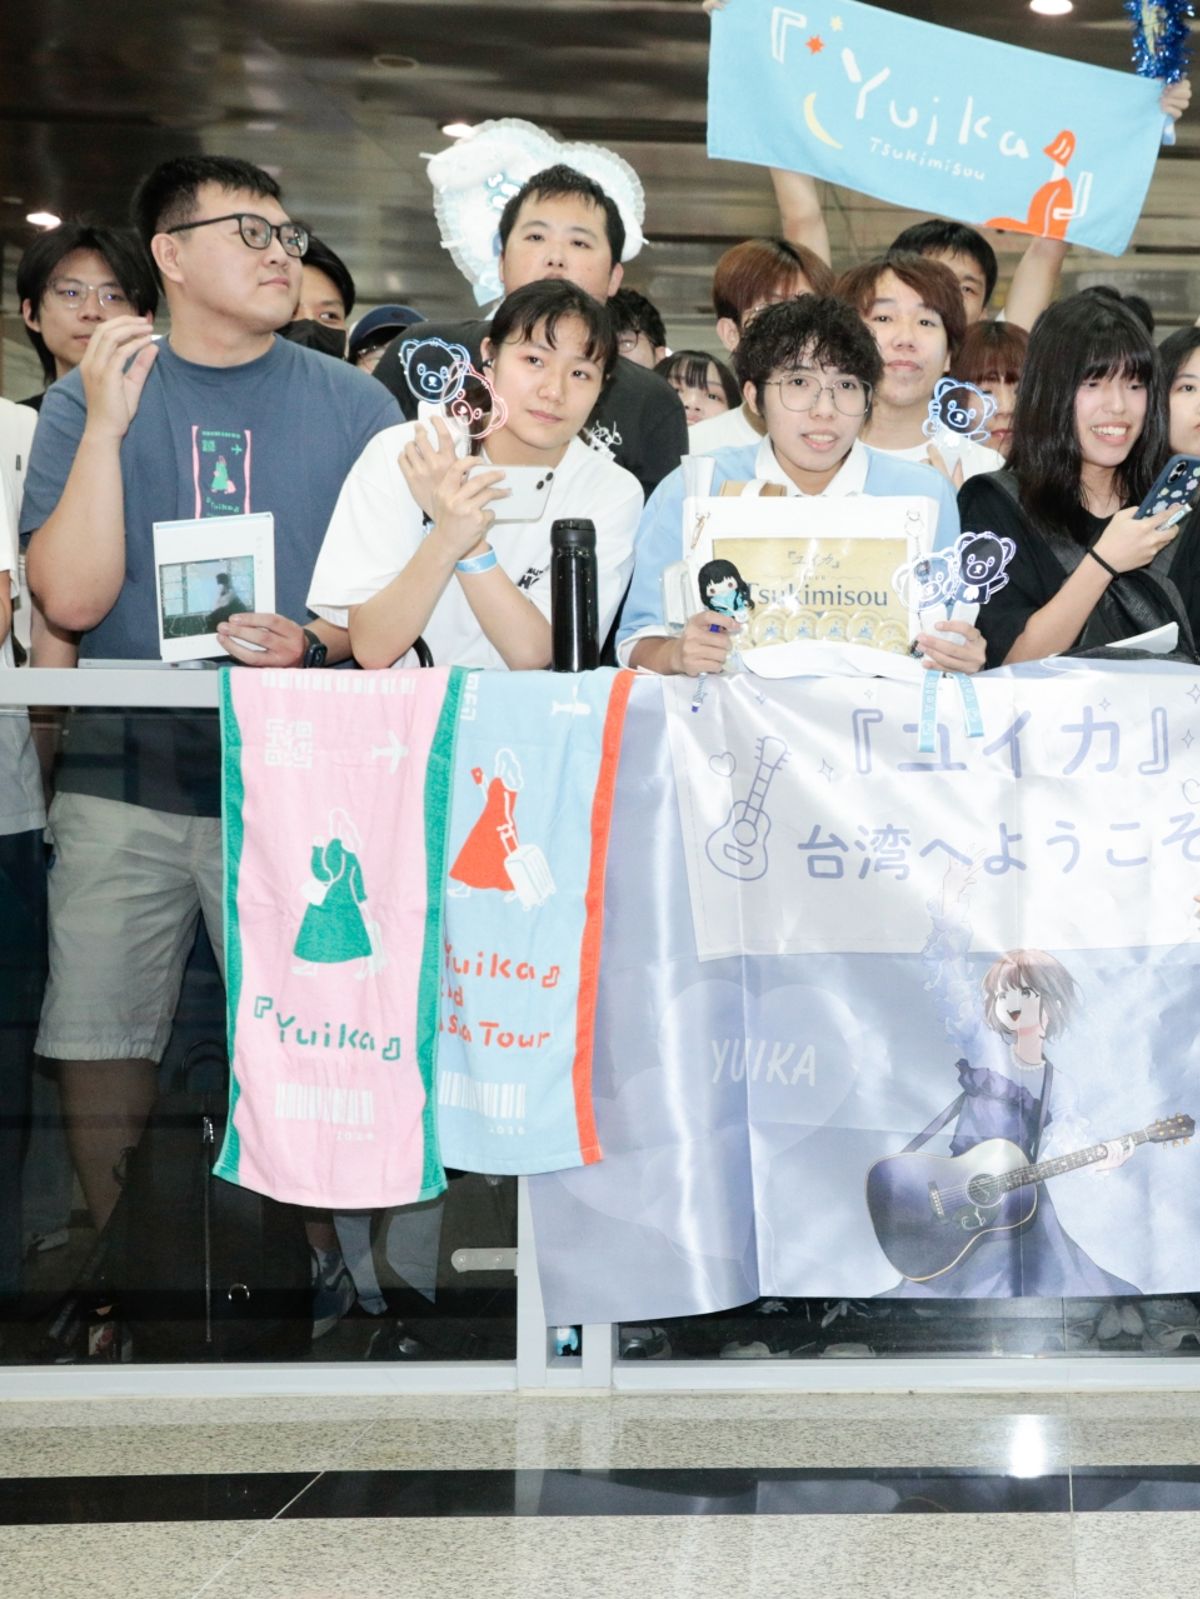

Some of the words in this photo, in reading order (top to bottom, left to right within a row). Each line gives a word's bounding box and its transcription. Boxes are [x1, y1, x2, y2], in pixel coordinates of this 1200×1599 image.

[851, 706, 1170, 778] 『ユイカ』
[479, 1021, 551, 1048] Tour
[711, 1038, 817, 1087] YUIKA
